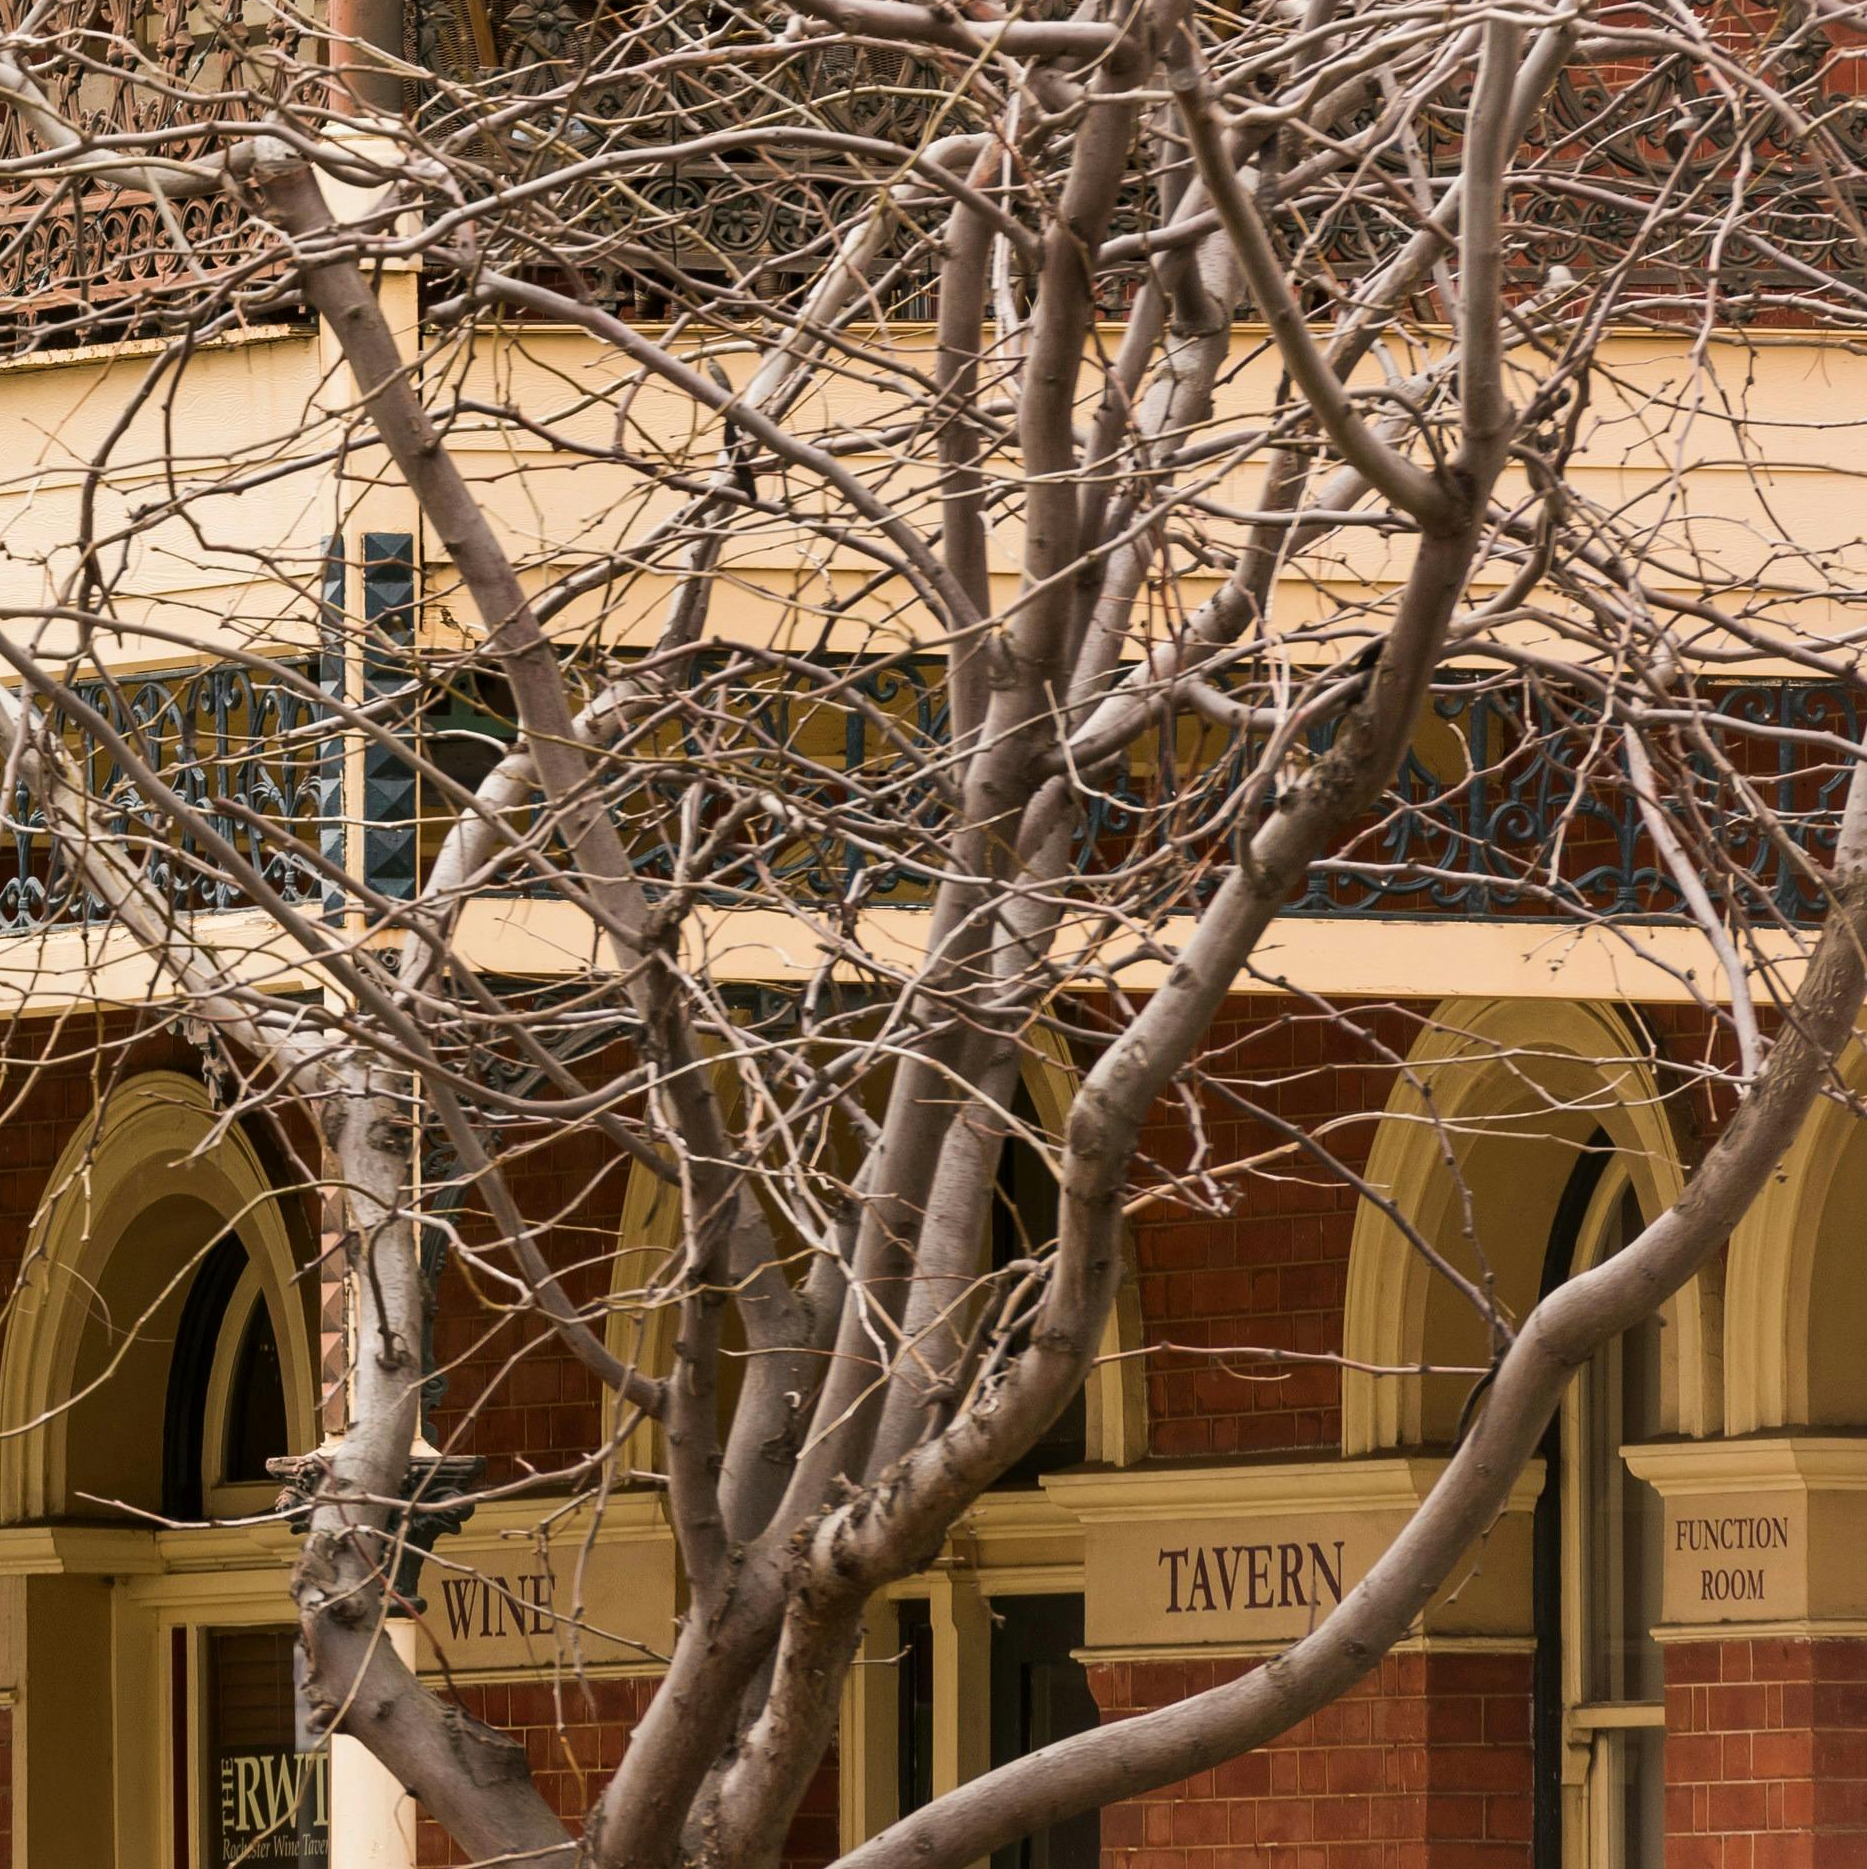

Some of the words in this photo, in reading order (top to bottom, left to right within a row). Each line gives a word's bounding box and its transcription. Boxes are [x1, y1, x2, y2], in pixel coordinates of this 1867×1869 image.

[1675, 1517, 1788, 1551] FUNCTION
[441, 1575, 556, 1640] WINE
[1158, 1540, 1345, 1614] TAVERN
[1701, 1569, 1765, 1600] ROOM
[221, 1757, 234, 1835] THE
[234, 1754, 328, 1831] RWT
[274, 1835, 299, 1858] Wine
